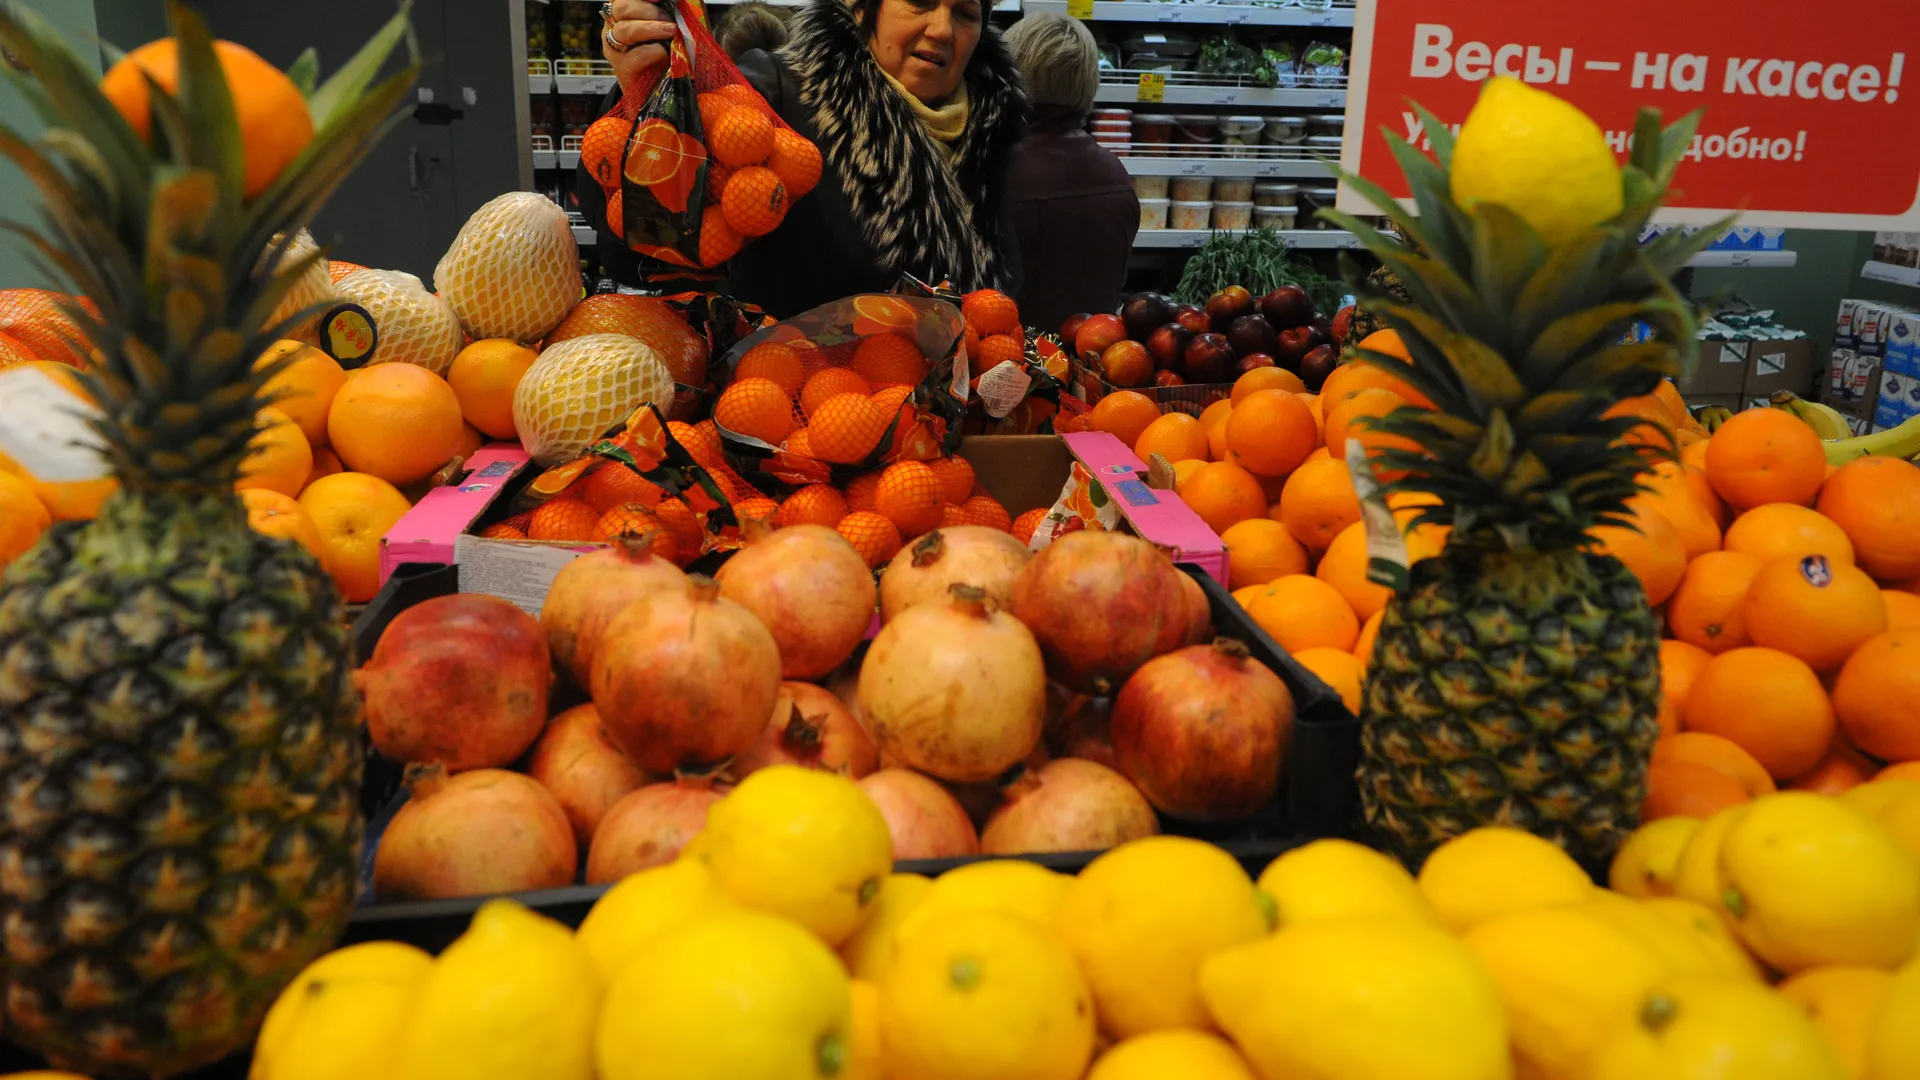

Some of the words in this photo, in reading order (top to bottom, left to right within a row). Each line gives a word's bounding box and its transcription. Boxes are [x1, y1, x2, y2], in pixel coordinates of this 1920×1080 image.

[1410, 23, 1574, 85] Весы
[1630, 51, 1709, 92] на
[1723, 52, 1905, 104] кассе!
[1676, 126, 1807, 162] добно!
